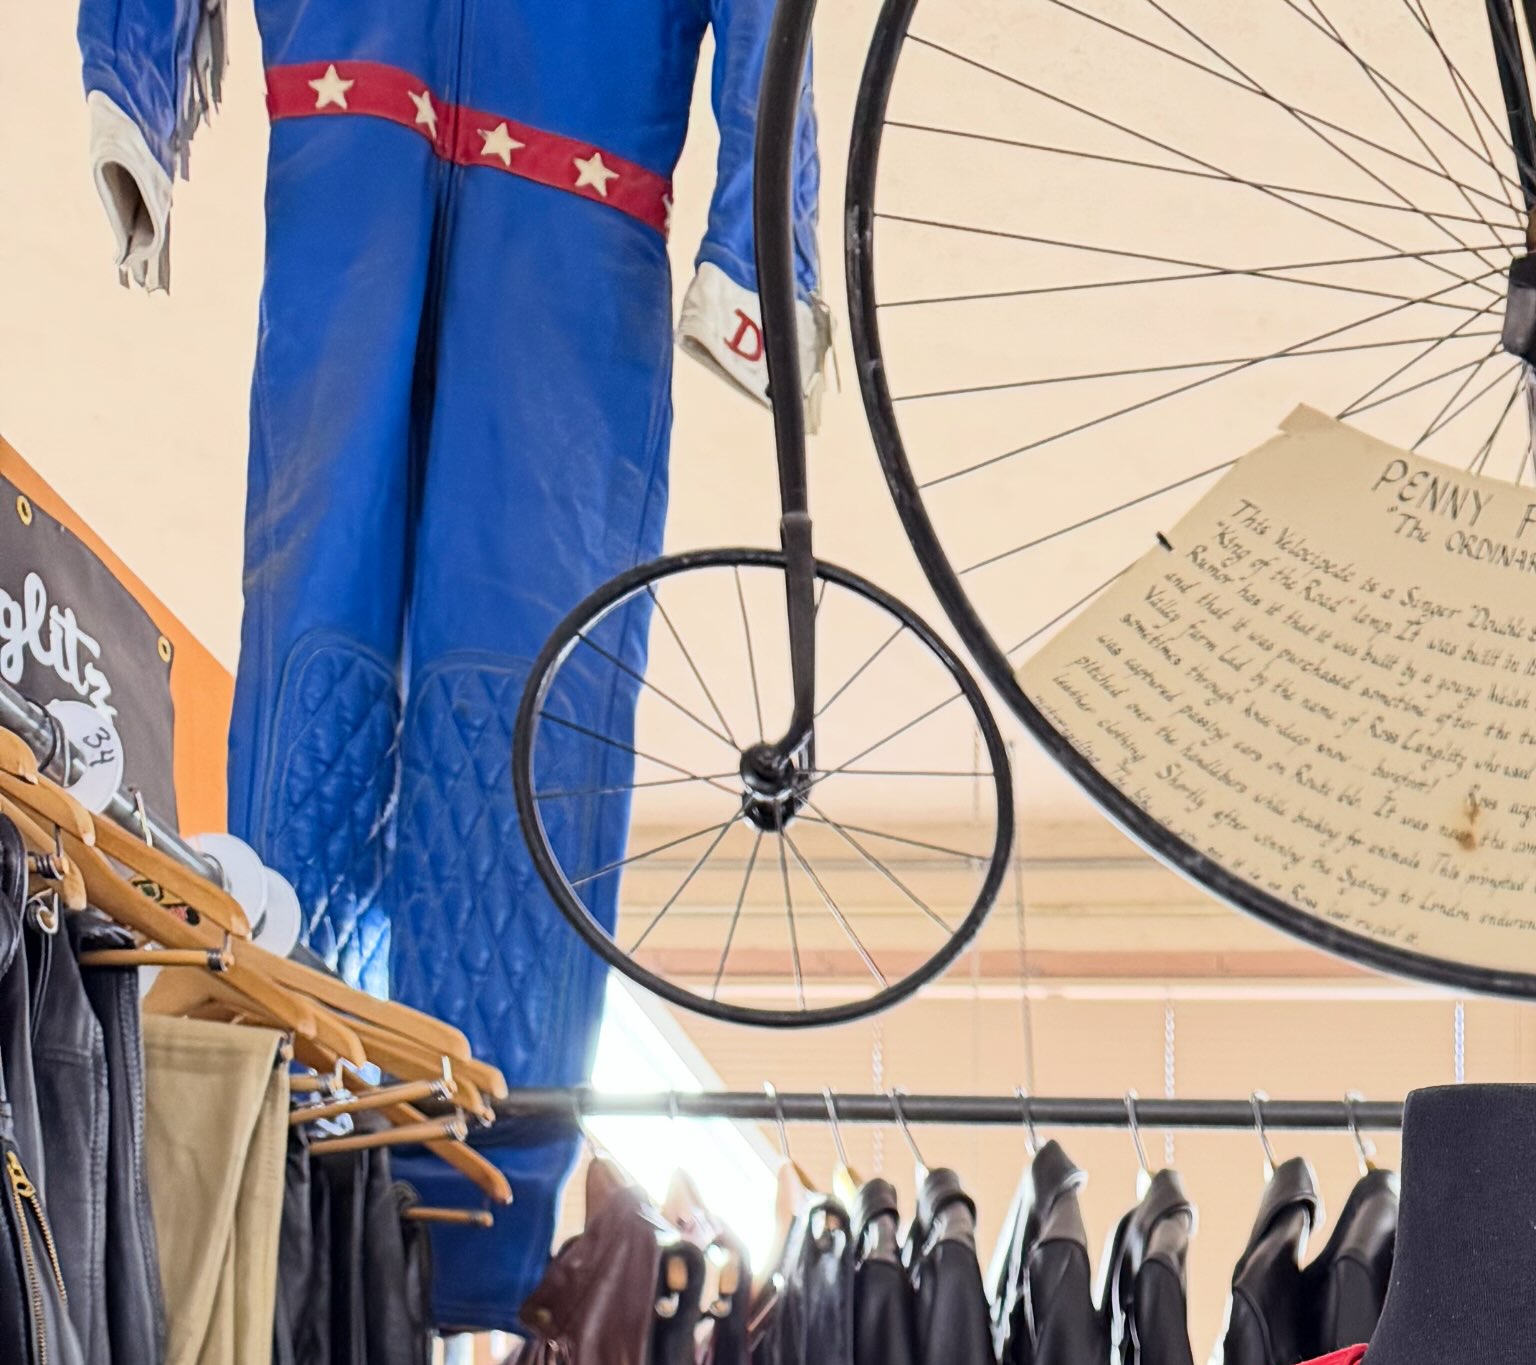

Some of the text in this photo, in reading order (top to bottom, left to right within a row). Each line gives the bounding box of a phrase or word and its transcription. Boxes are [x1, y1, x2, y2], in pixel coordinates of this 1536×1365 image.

[1371, 459, 1495, 527] PENNY
[1231, 498, 1272, 536] This
[1359, 576, 1381, 594] is
[1380, 588, 1396, 600] a
[1163, 571, 1201, 595] and
[1196, 591, 1235, 620] that
[1231, 616, 1250, 633] it
[1247, 631, 1275, 652] was
[1483, 721, 1512, 741] the
[1186, 543, 1234, 584] Rumor
[1236, 582, 1262, 607] has
[1264, 602, 1286, 617] it
[1282, 609, 1317, 636] that
[1315, 628, 1333, 644] it
[1333, 641, 1358, 657] was
[1361, 644, 1400, 671] built
[1396, 660, 1418, 686] by
[1270, 567, 1298, 591] the
[1394, 618, 1422, 643] It
[1426, 638, 1458, 657] was
[1461, 640, 1501, 667] built
[1503, 655, 1519, 673] in
[1095, 633, 1126, 657] was
[1373, 789, 1398, 820] It
[1400, 816, 1430, 833] was
[1270, 678, 1296, 701] the
[1300, 697, 1337, 721] name
[1369, 714, 1400, 746] Ross
[1474, 750, 1501, 773] who
[1155, 725, 1179, 747] the
[1429, 851, 1461, 881] This
[1311, 857, 1333, 876] the
